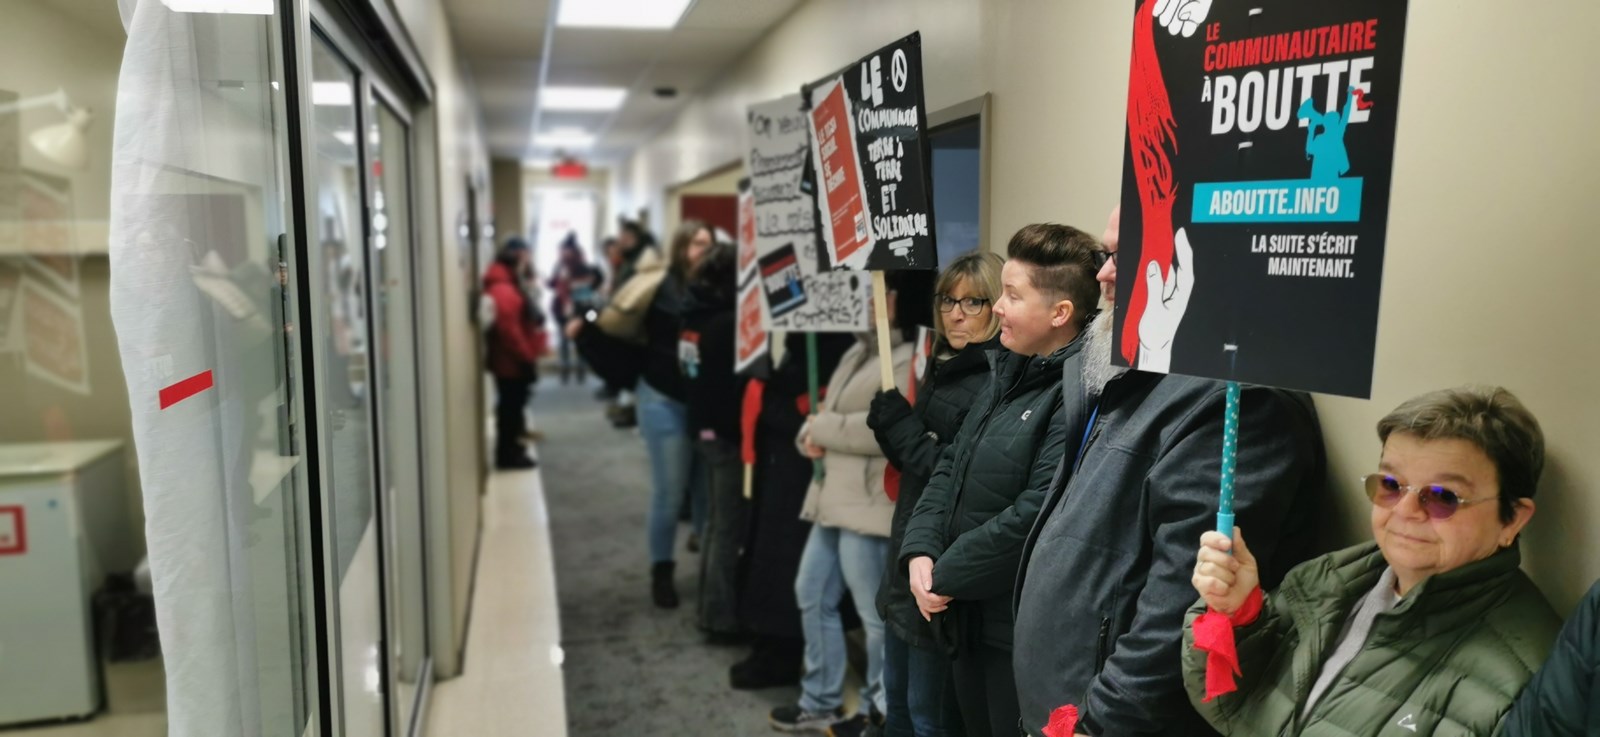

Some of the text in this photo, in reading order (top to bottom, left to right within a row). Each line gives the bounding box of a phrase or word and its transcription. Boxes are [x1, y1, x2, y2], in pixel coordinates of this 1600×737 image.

[1204, 19, 1378, 72] COMMUNAUTAIRE
[1206, 22, 1221, 42] LE
[861, 55, 883, 108] LE
[1201, 56, 1375, 135] À BOUTTE
[868, 136, 894, 162] TERRE
[875, 158, 902, 182] TERRE
[881, 183, 897, 215] ET
[1209, 186, 1340, 215] ABOUTTE.INFO
[873, 212, 928, 241] SOLIDAIRE
[1251, 231, 1358, 255] LA SUITE S'ÉCRIT
[1268, 257, 1355, 278] MAINTENANT.
